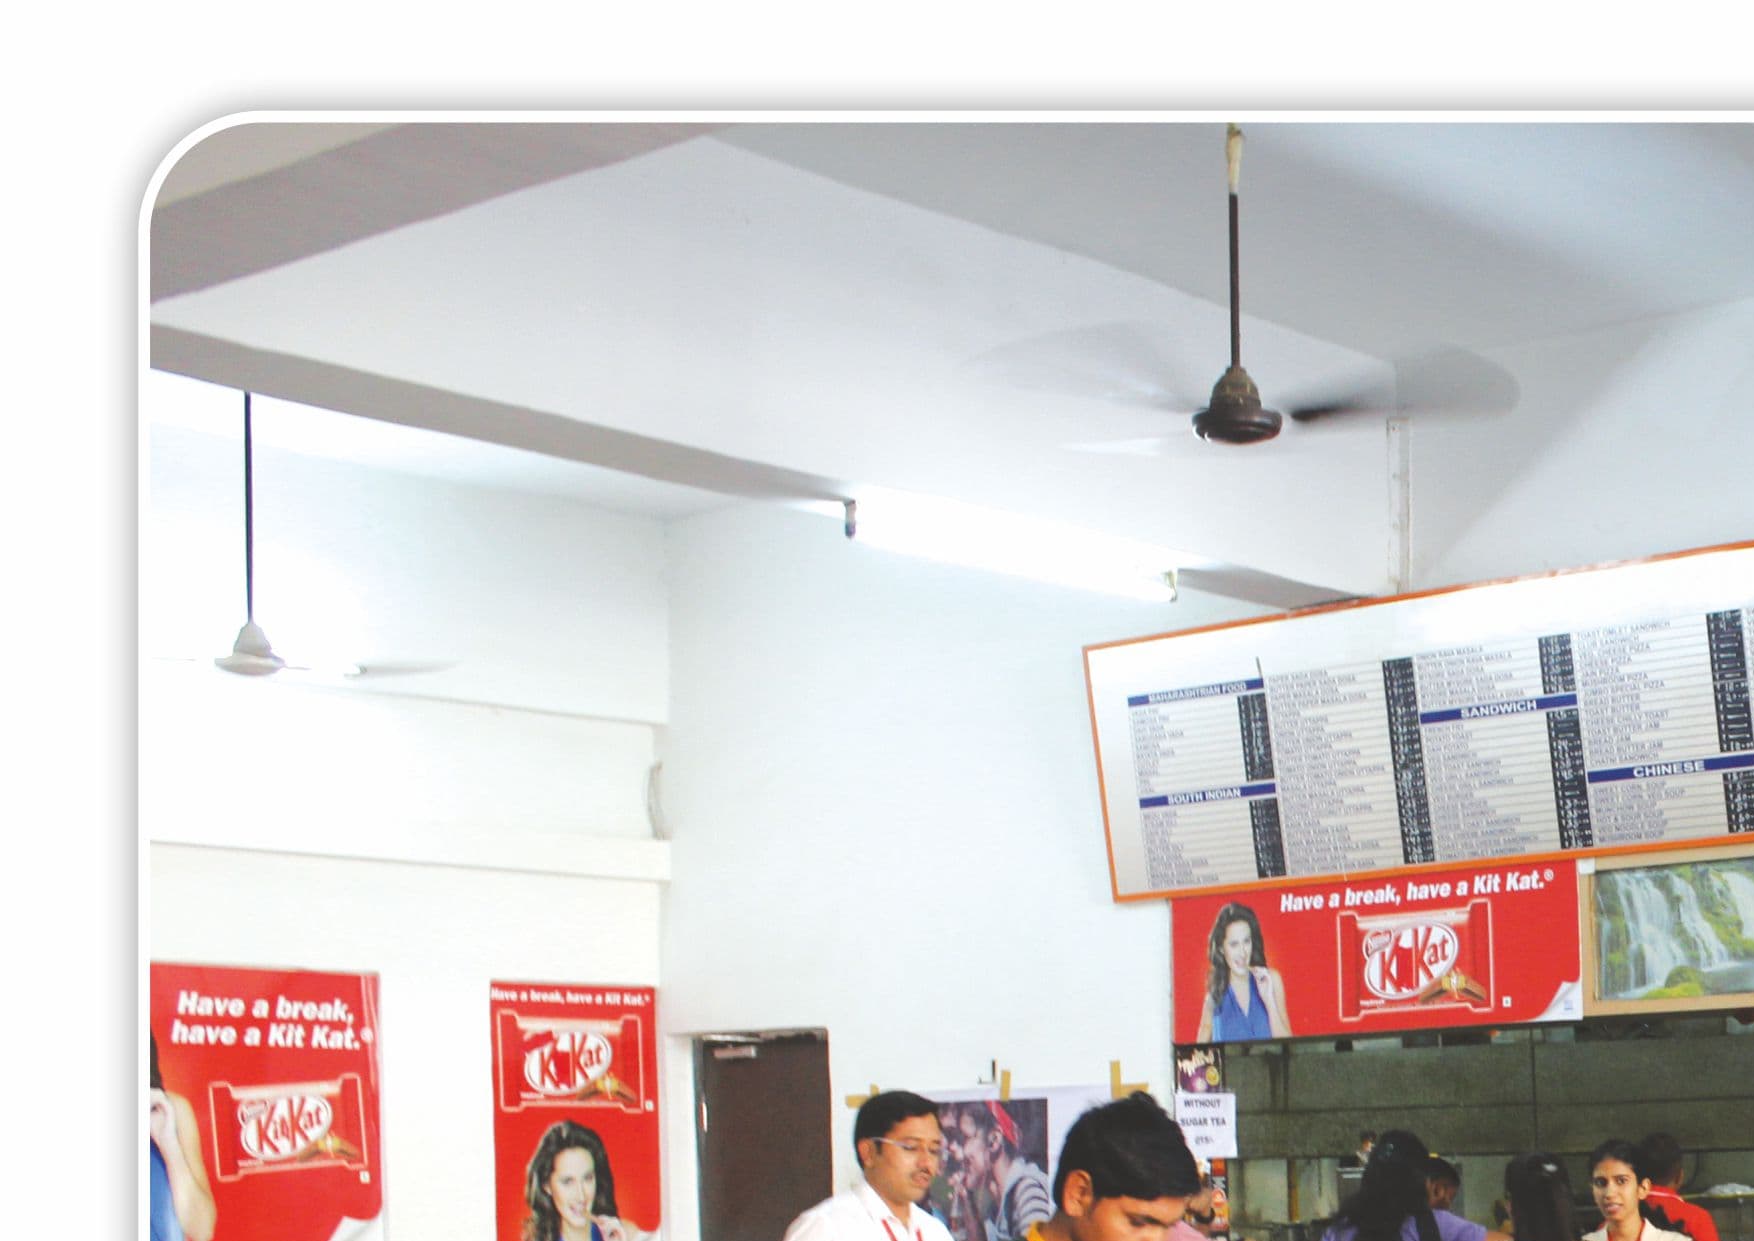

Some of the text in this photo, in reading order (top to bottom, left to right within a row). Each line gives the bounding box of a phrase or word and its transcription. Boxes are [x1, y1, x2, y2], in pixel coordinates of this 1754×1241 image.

[1148, 680, 1247, 703] MAHARASHTRIAN FOOD
[1460, 699, 1537, 719] SANDWICH
[1632, 759, 1705, 778] CHINESE
[1167, 786, 1241, 805] SOUTH INDIAN
[1280, 893, 1324, 912] Have
[1328, 895, 1340, 909] a
[1344, 887, 1402, 907] break,
[1406, 881, 1451, 901] have
[1456, 882, 1469, 897] a
[1473, 874, 1500, 895] Kit
[491, 988, 518, 1001] Have
[520, 991, 528, 1001] a
[566, 991, 593, 1005] have
[594, 994, 603, 1004] a
[605, 992, 622, 1006] Kit
[177, 990, 354, 1024] Have a break,
[171, 1019, 238, 1046] have
[243, 1026, 261, 1047] a
[267, 1023, 306, 1048] Kit
[1184, 1099, 1221, 1108] WITHOUT
[1180, 1117, 1226, 1127] SUGAR TEA
